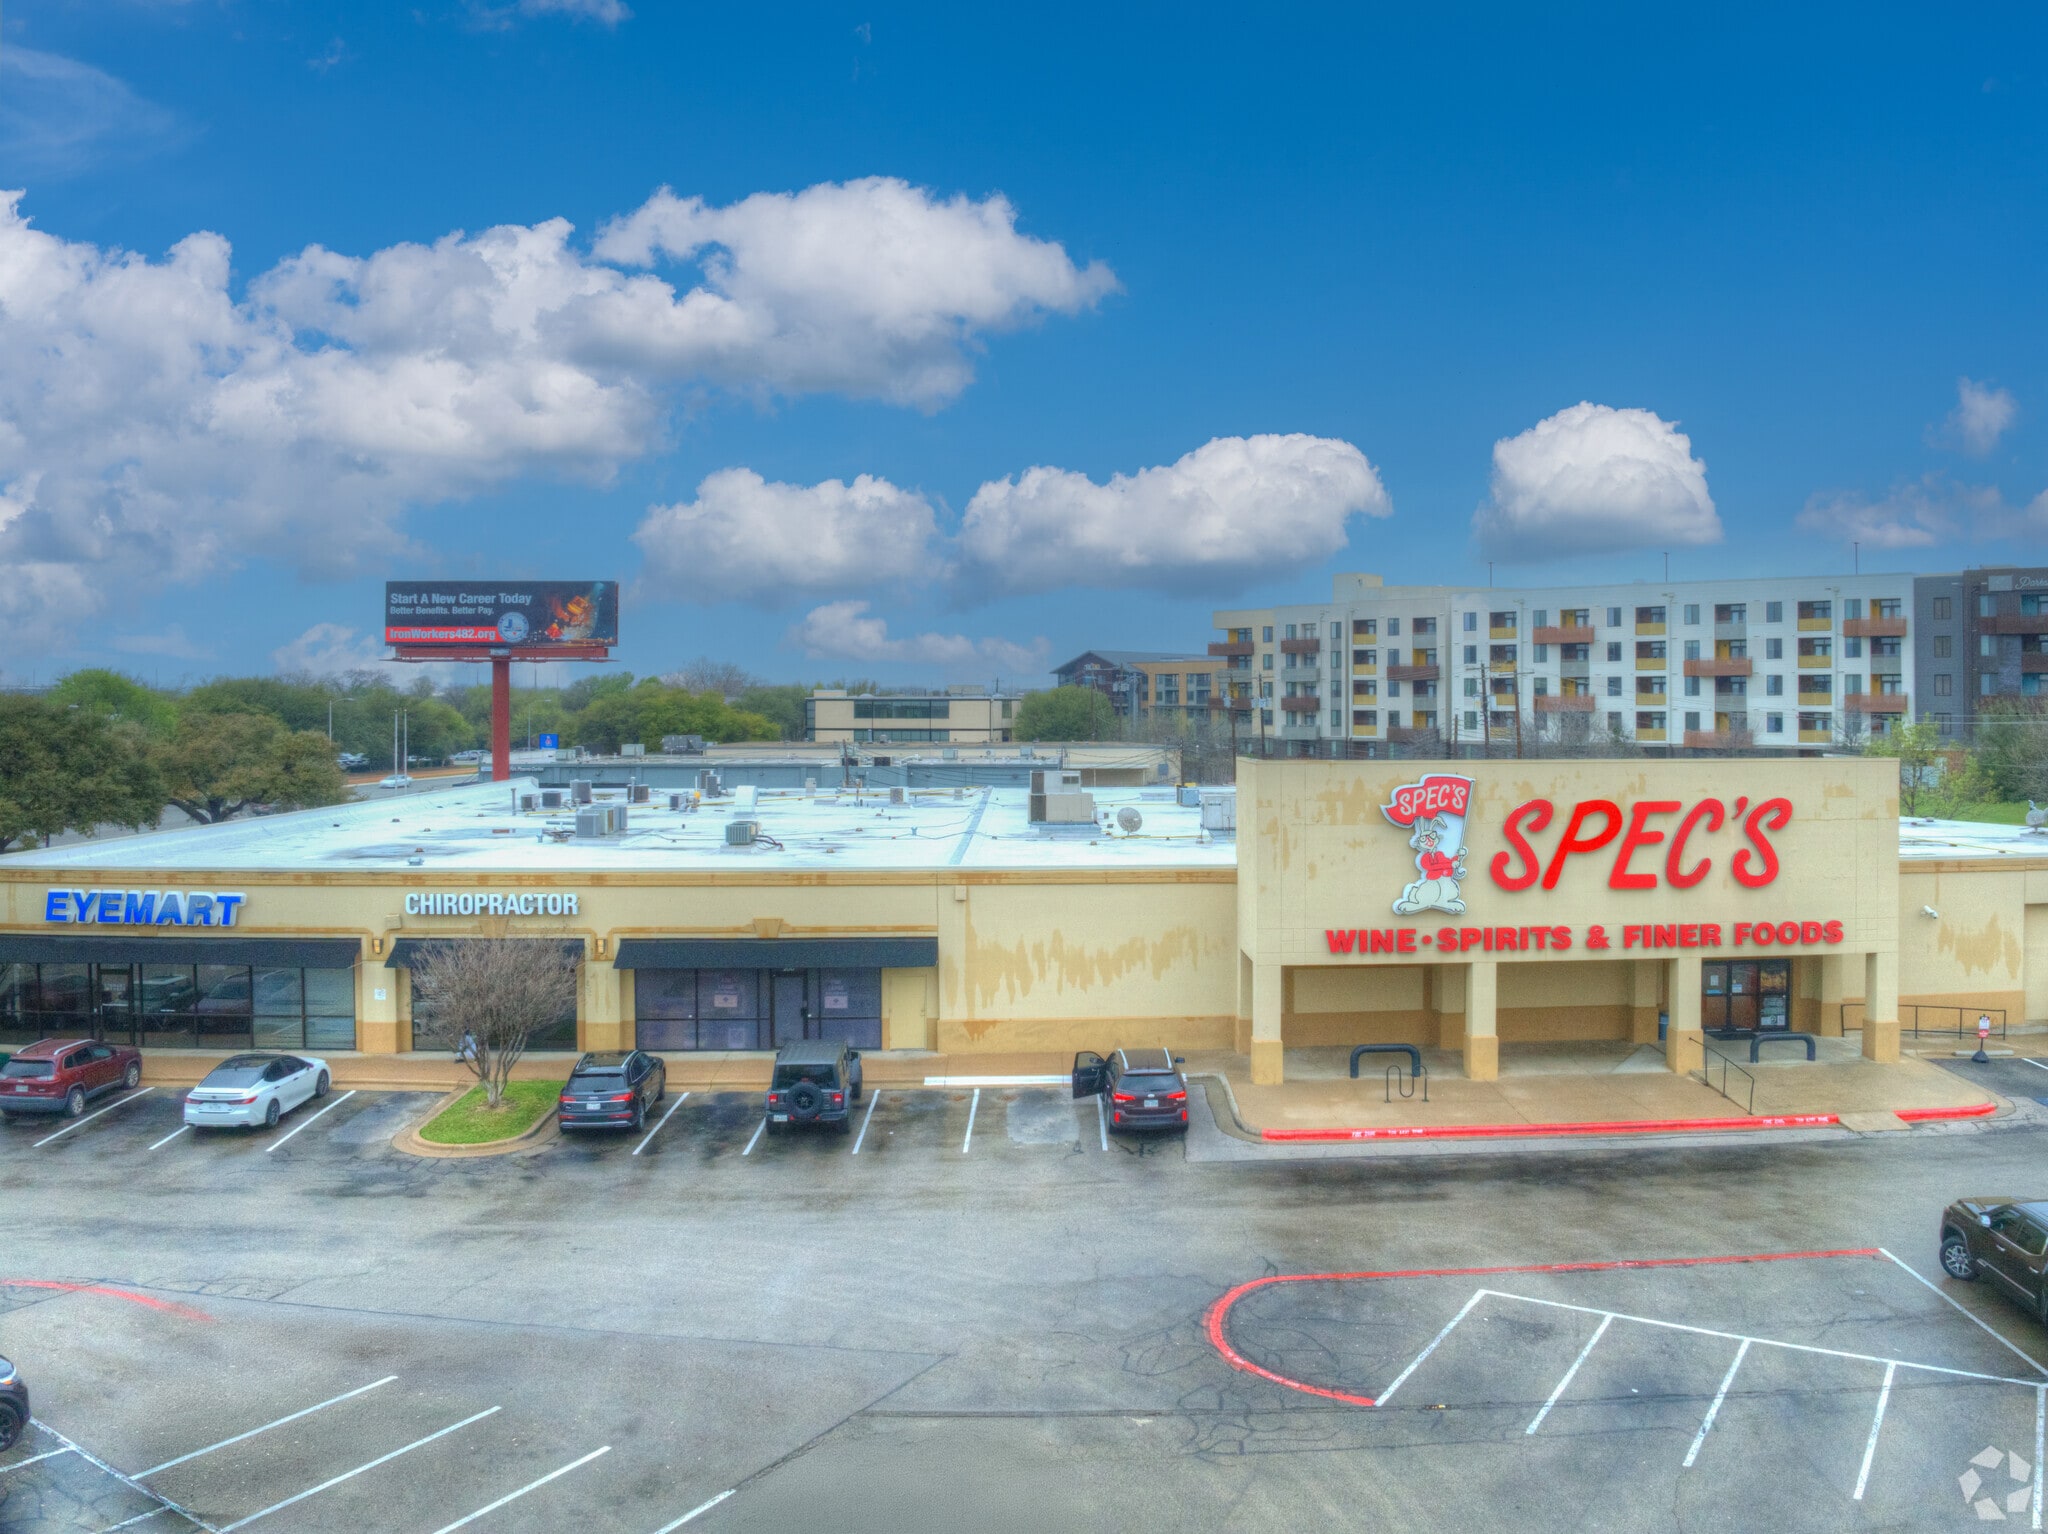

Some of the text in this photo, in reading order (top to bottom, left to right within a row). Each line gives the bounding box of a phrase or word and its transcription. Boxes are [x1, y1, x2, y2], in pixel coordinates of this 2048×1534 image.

[390, 593, 532, 605] Start A New Career Today
[390, 606, 494, 616] Better Benefits. Better Pay.
[389, 628, 496, 640] IronWorkers482.org
[1399, 784, 1467, 816] SPEC'S
[1489, 796, 1794, 891] SPEC'S
[45, 889, 246, 926] EYEMART
[405, 892, 579, 916] CHIROPRACTOR
[1325, 920, 1845, 953] WINE SPIRITS & FINER FOODS
